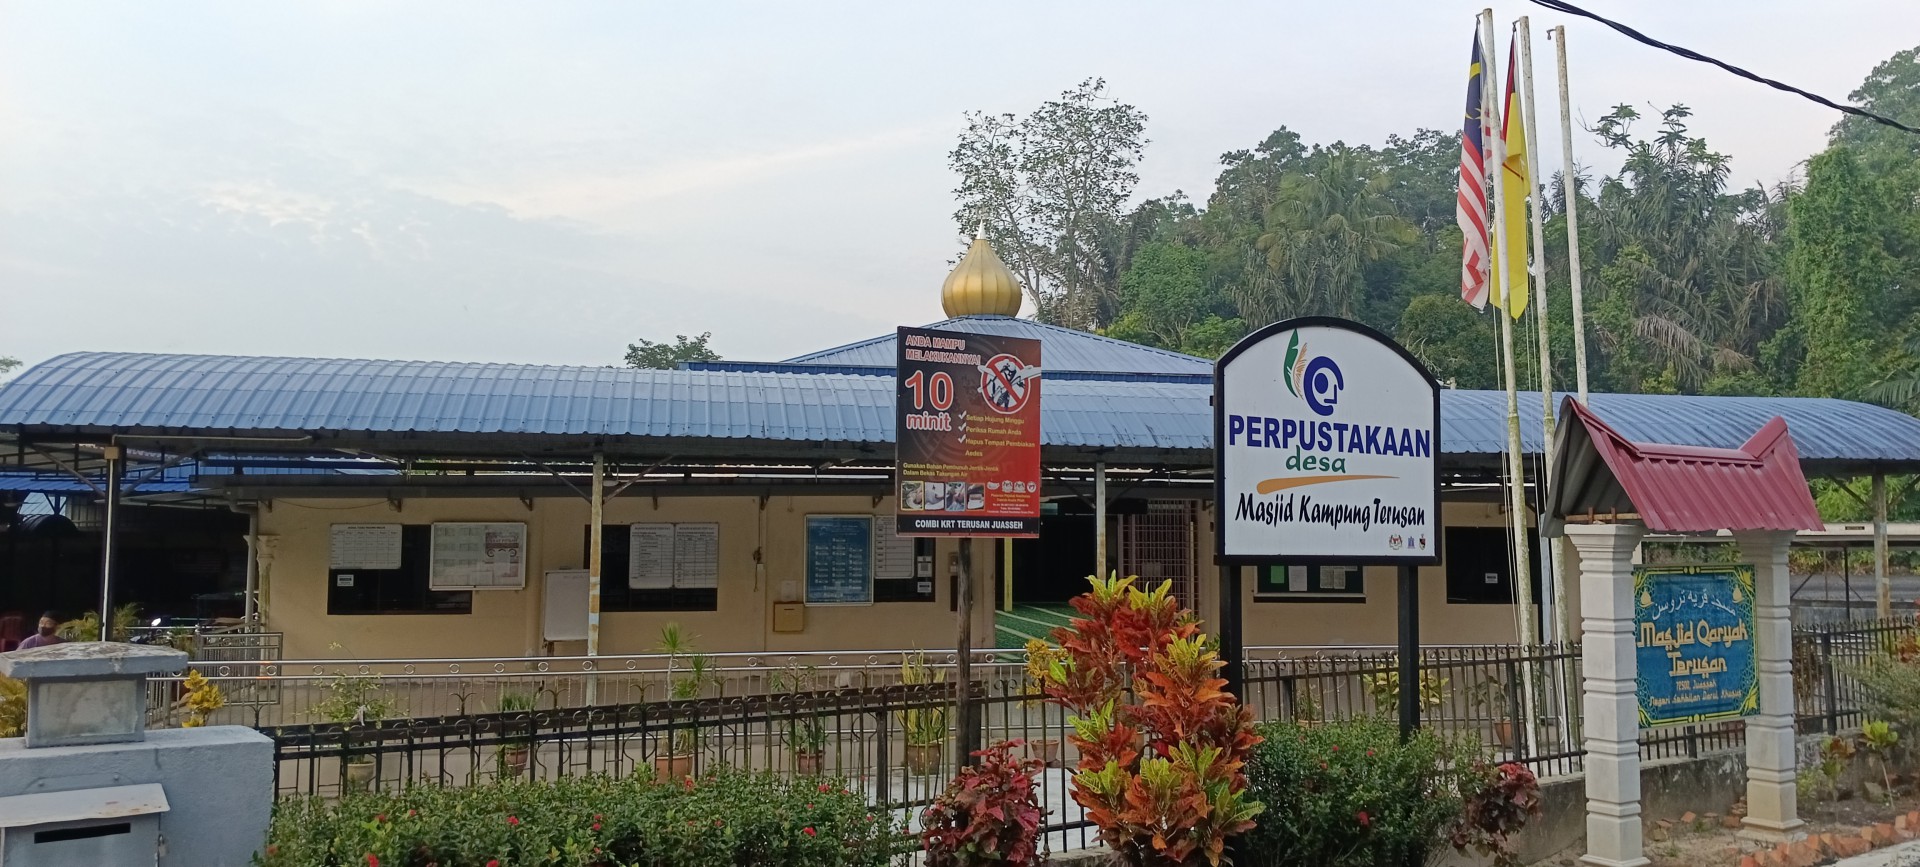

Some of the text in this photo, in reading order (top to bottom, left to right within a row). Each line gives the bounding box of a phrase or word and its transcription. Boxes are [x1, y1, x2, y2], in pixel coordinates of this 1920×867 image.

[905, 335, 966, 351] ANDA MAMPU
[905, 348, 981, 366] MELAKUKANNYA!
[905, 369, 954, 411] 10
[906, 411, 952, 432] minit
[985, 416, 1004, 424] Hujung
[966, 426, 1022, 436] Periksa Rumah Anda
[1229, 414, 1431, 458] PERPUSTAKAAN
[966, 438, 1036, 448] Hapus Tempat Pembiakan
[1285, 445, 1347, 474] desa
[1235, 493, 1425, 532] Masjid Kampung Terusan
[915, 519, 1023, 530] COMBI KRT TERUSAN JUASSEH
[1637, 617, 1749, 651] Masjid Qaryah
[1667, 651, 1728, 679] Terusan
